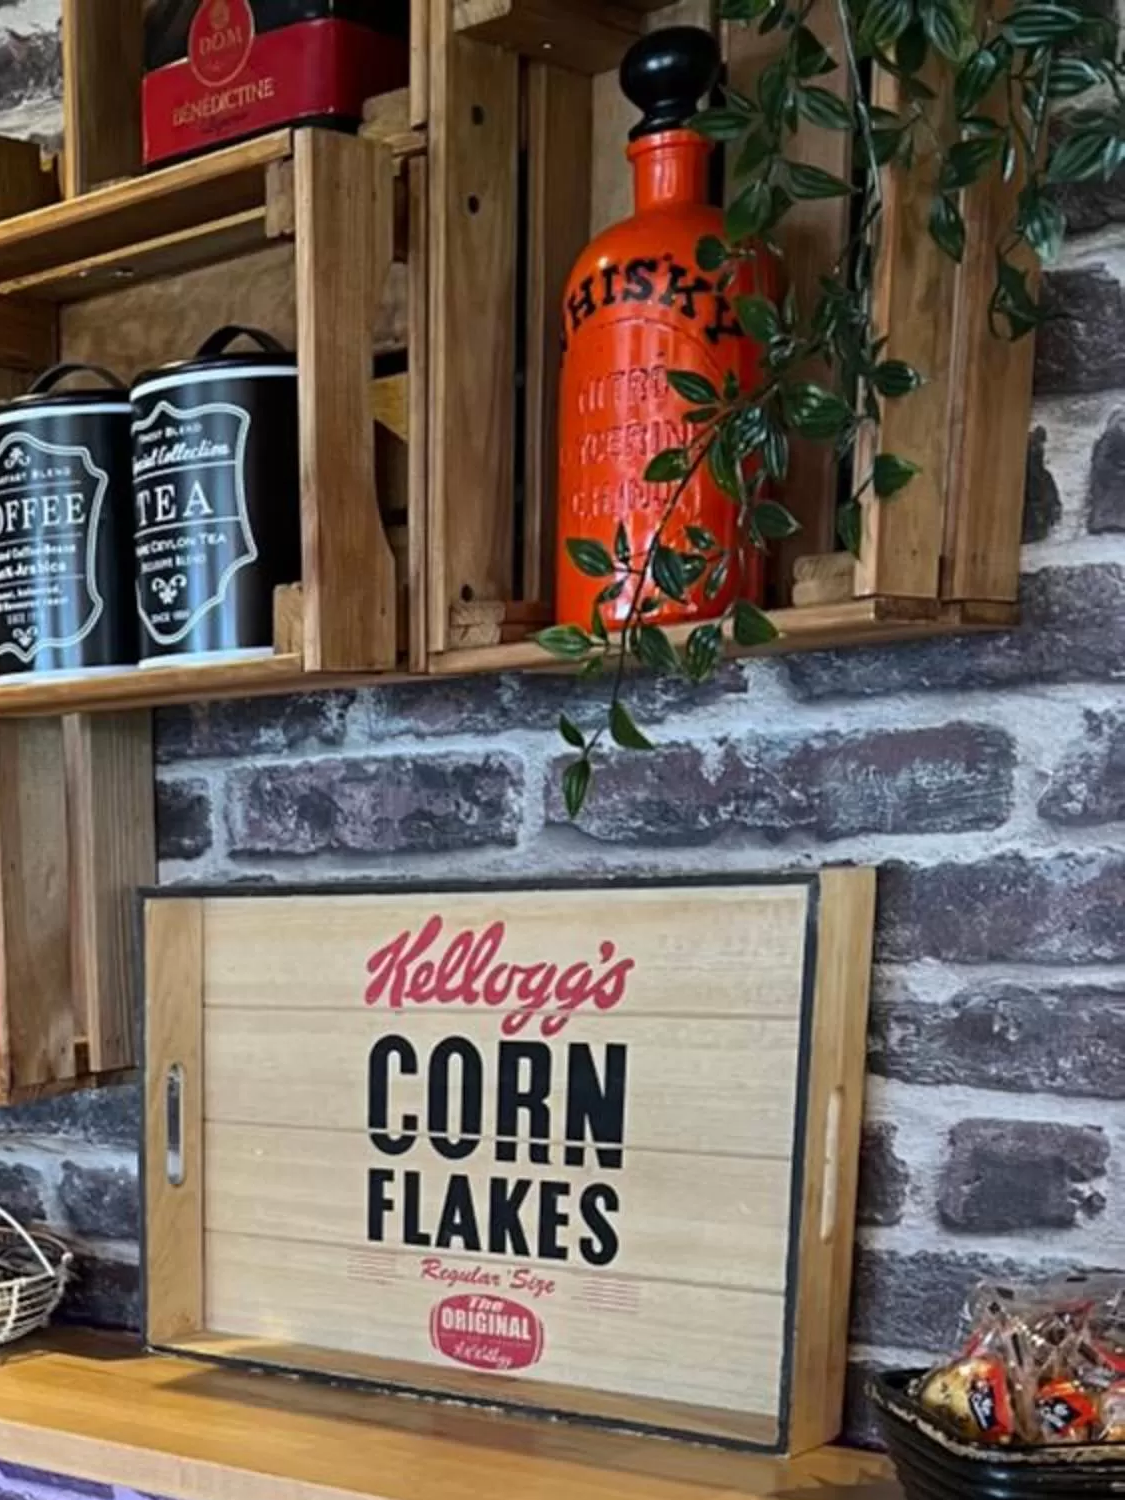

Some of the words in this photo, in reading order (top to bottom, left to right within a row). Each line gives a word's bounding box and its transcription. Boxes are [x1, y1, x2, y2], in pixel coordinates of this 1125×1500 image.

[560, 253, 744, 352] HISKY
[137, 480, 214, 527] TEA
[198, 532, 227, 546] TEA
[365, 914, 635, 1036] Kellogg's
[368, 1034, 628, 1169] CORN
[367, 1168, 620, 1266] FLAKES
[421, 1257, 501, 1288] Regular
[509, 1267, 556, 1298] Size
[442, 1307, 531, 1340] ORIGINAL
